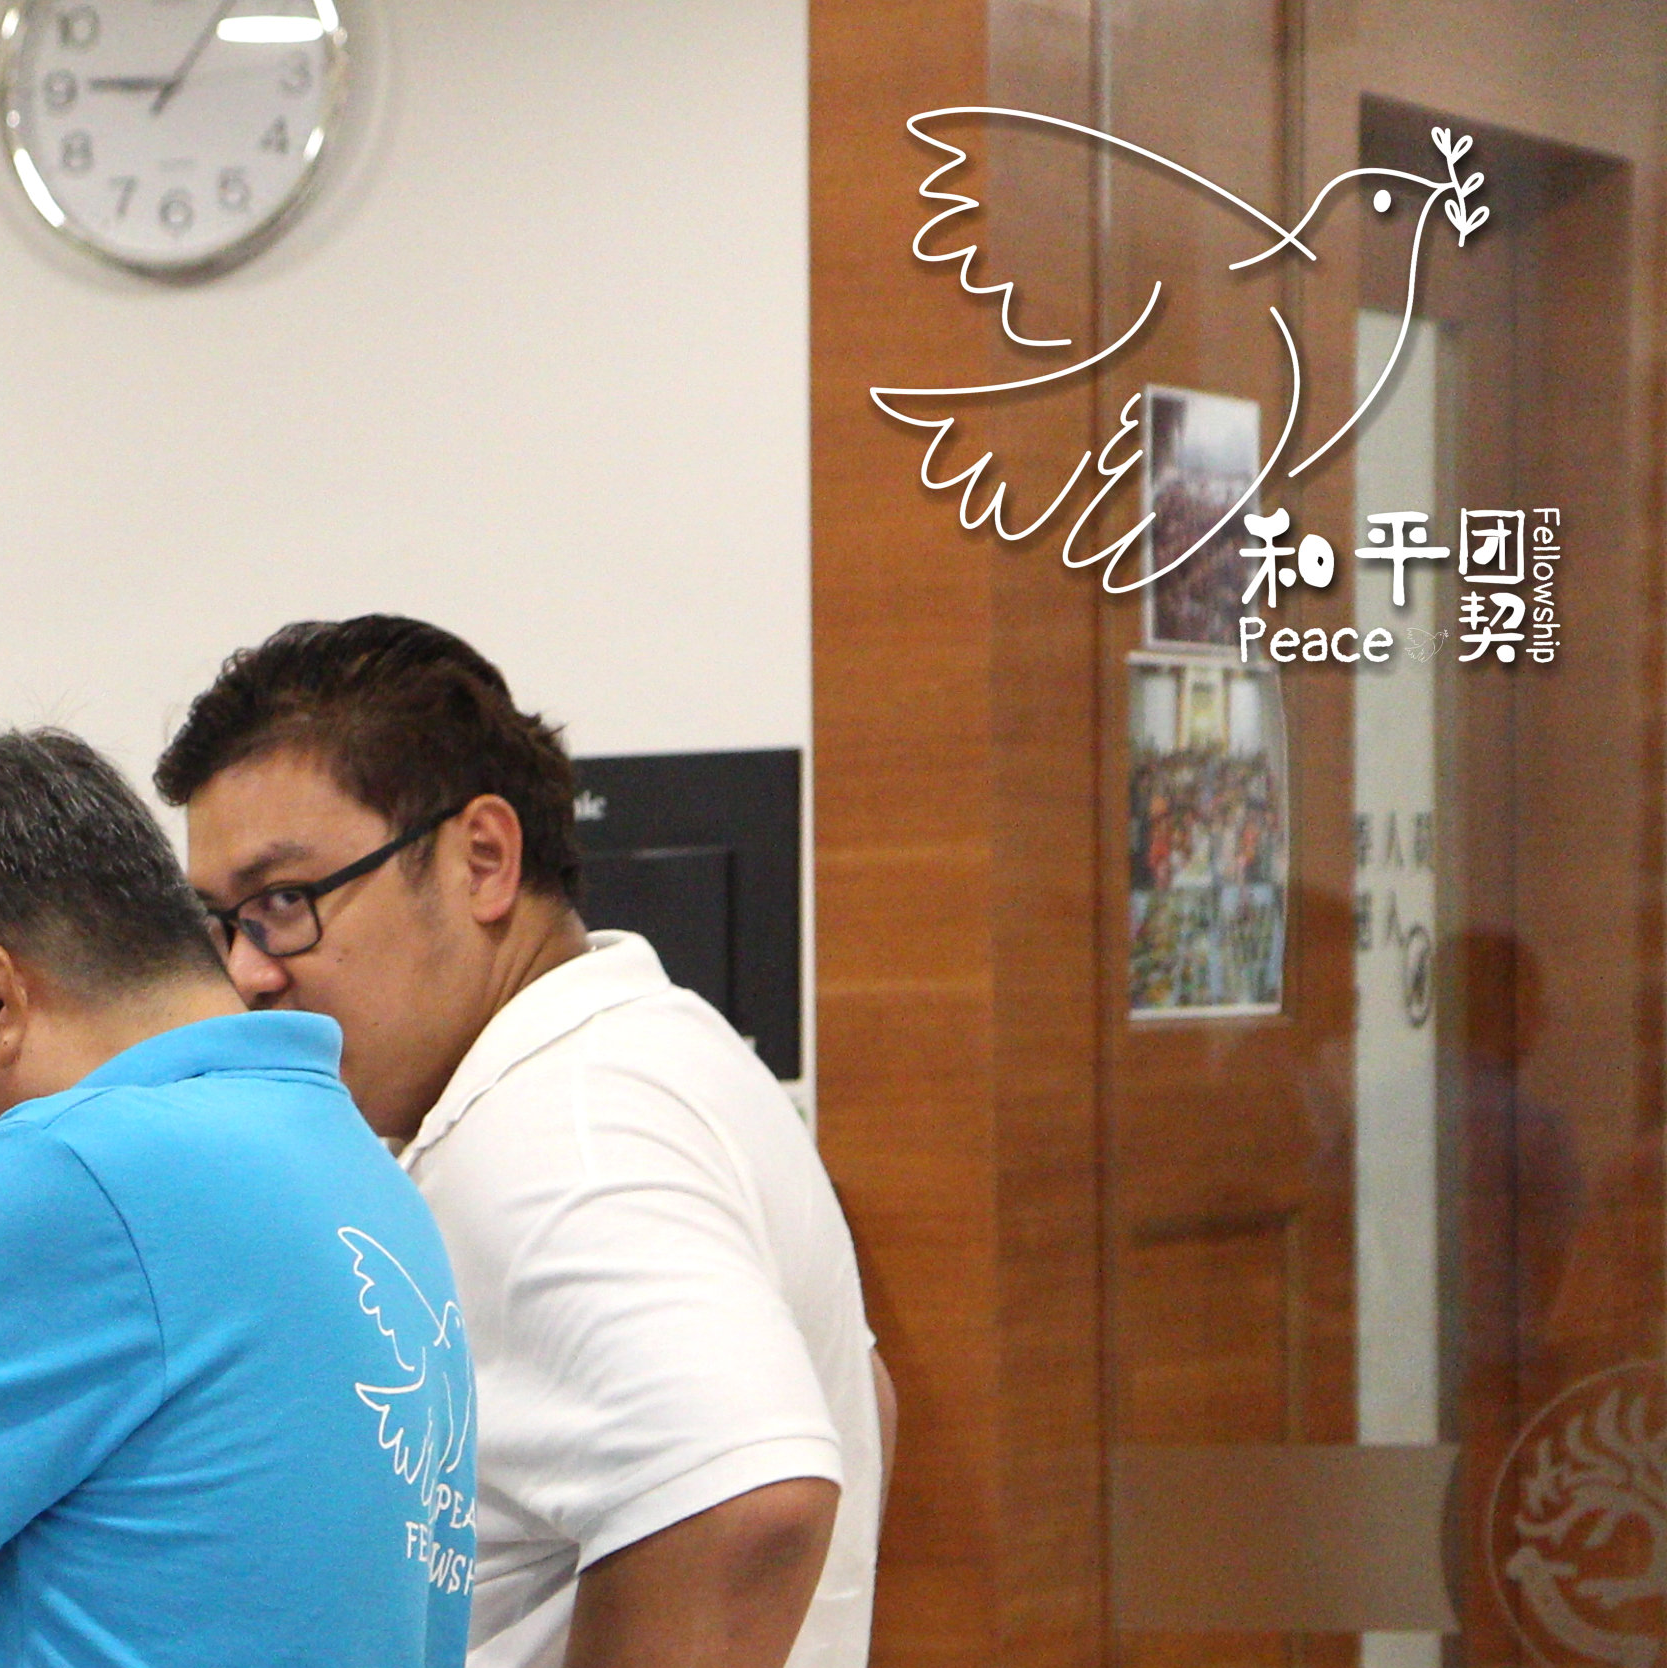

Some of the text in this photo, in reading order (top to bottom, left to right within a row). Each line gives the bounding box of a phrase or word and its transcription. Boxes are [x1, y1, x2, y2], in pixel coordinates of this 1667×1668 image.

[56, 7, 100, 49] 10
[44, 68, 78, 112] 9
[278, 51, 312, 94] 3
[61, 129, 94, 172] 8
[261, 115, 288, 155] 4
[110, 175, 140, 217] 7
[158, 187, 193, 234] 6
[217, 168, 251, 211] 5
[428, 1483, 477, 1537] PEA
